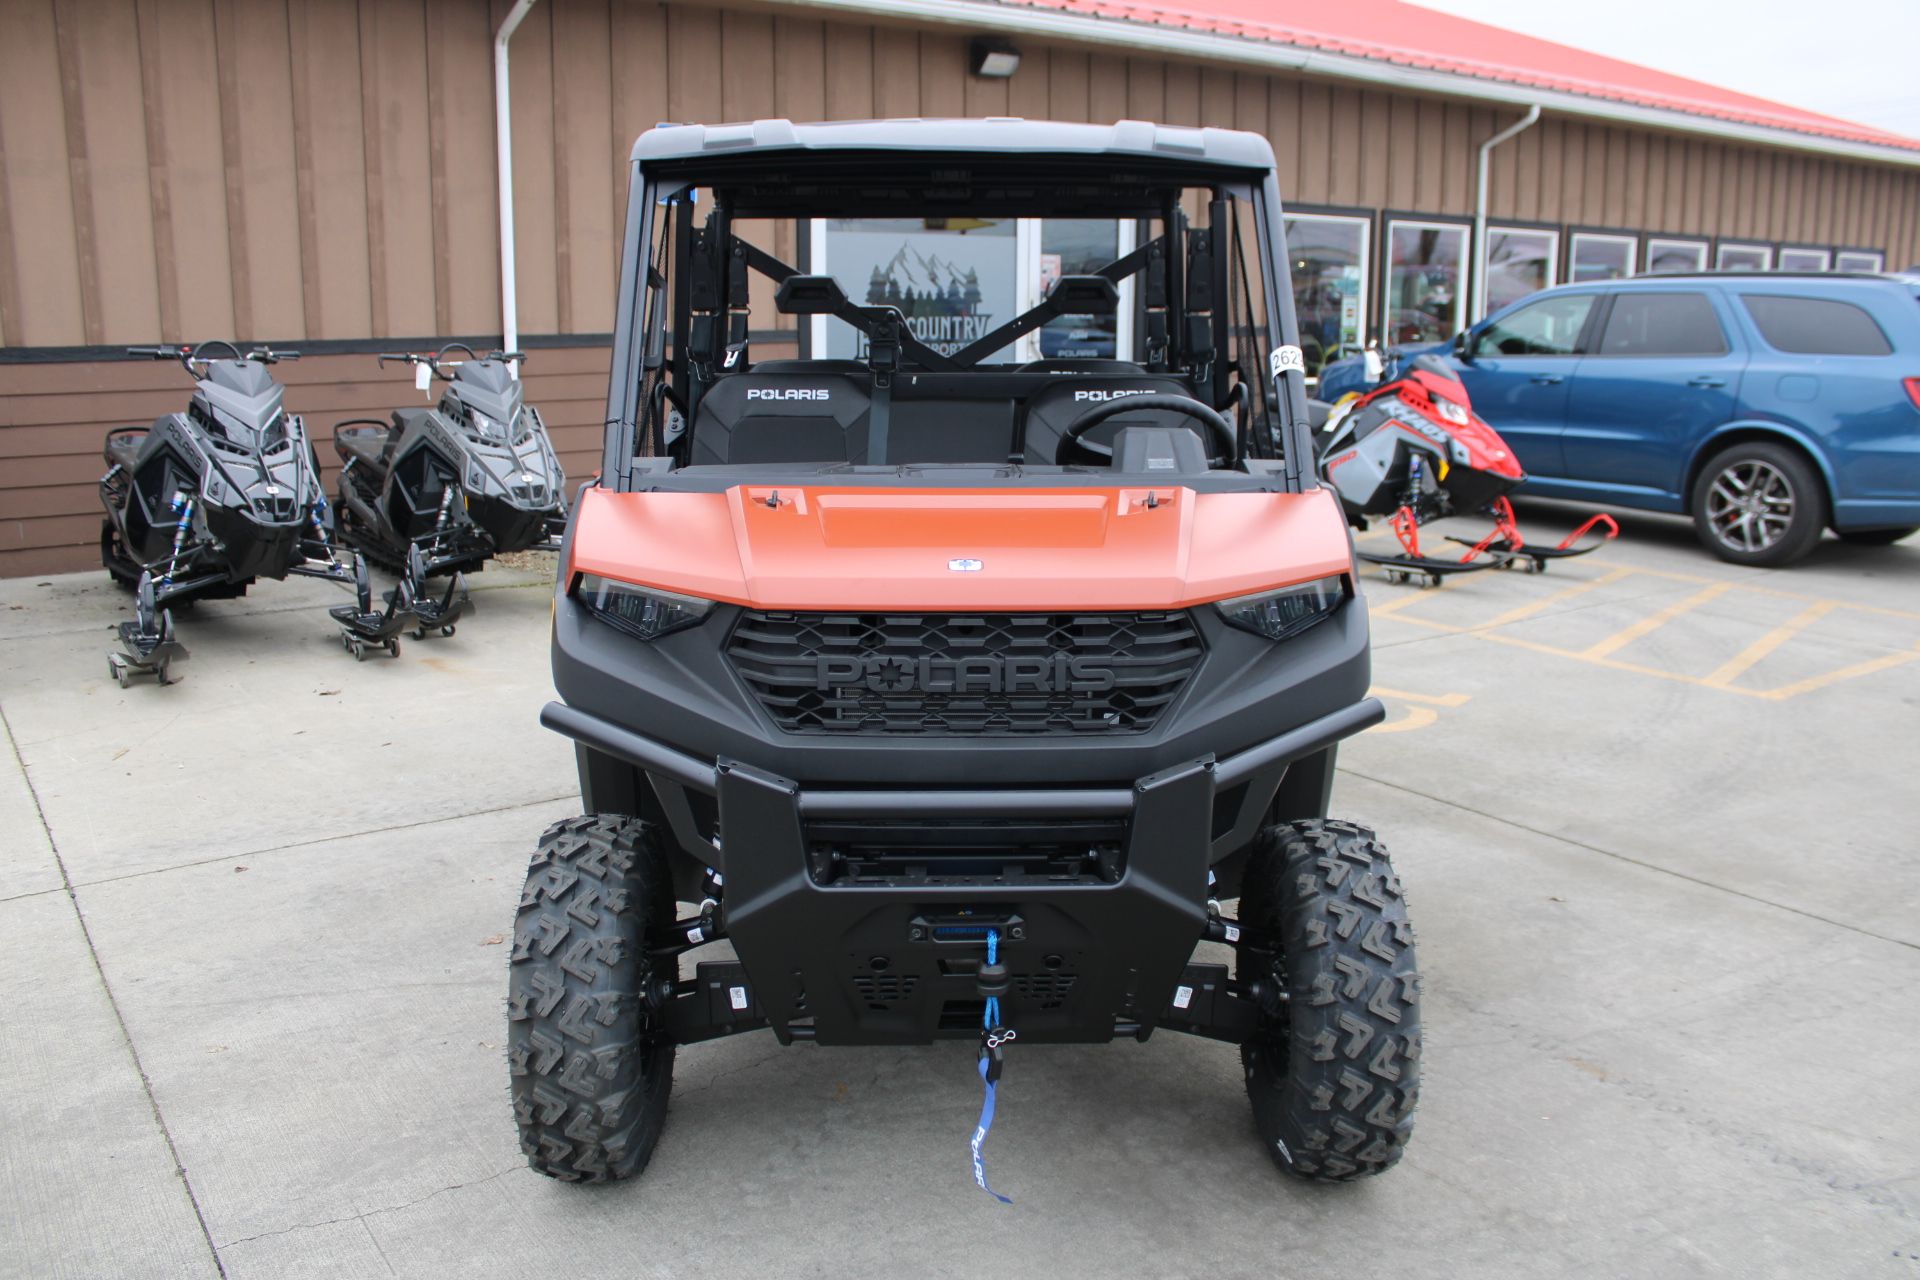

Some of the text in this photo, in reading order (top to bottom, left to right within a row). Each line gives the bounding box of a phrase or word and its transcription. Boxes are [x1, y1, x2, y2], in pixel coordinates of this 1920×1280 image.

[747, 384, 829, 401] POLARIS
[1075, 390, 1156, 401] POLA
[166, 423, 202, 468] POLARIS
[424, 419, 461, 461] POLARIS
[816, 655, 1115, 692] POLARIS
